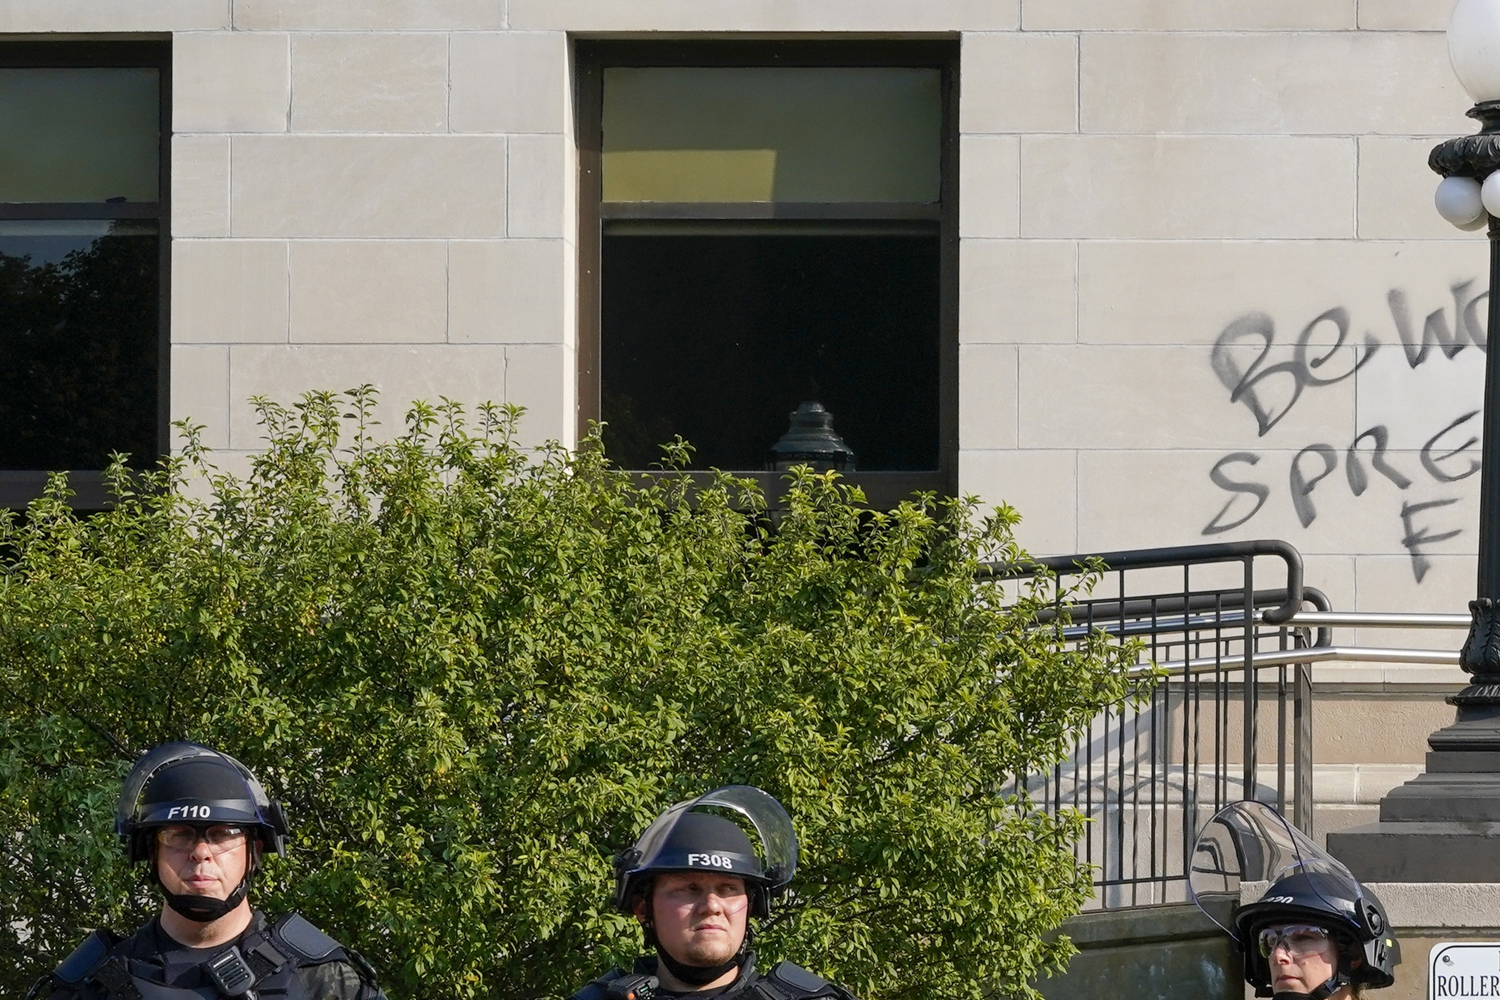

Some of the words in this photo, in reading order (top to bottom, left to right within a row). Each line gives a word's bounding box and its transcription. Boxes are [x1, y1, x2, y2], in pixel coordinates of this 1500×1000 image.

[167, 805, 211, 820] F110
[688, 853, 733, 870] F308
[1437, 975, 1500, 997] ROLLER
